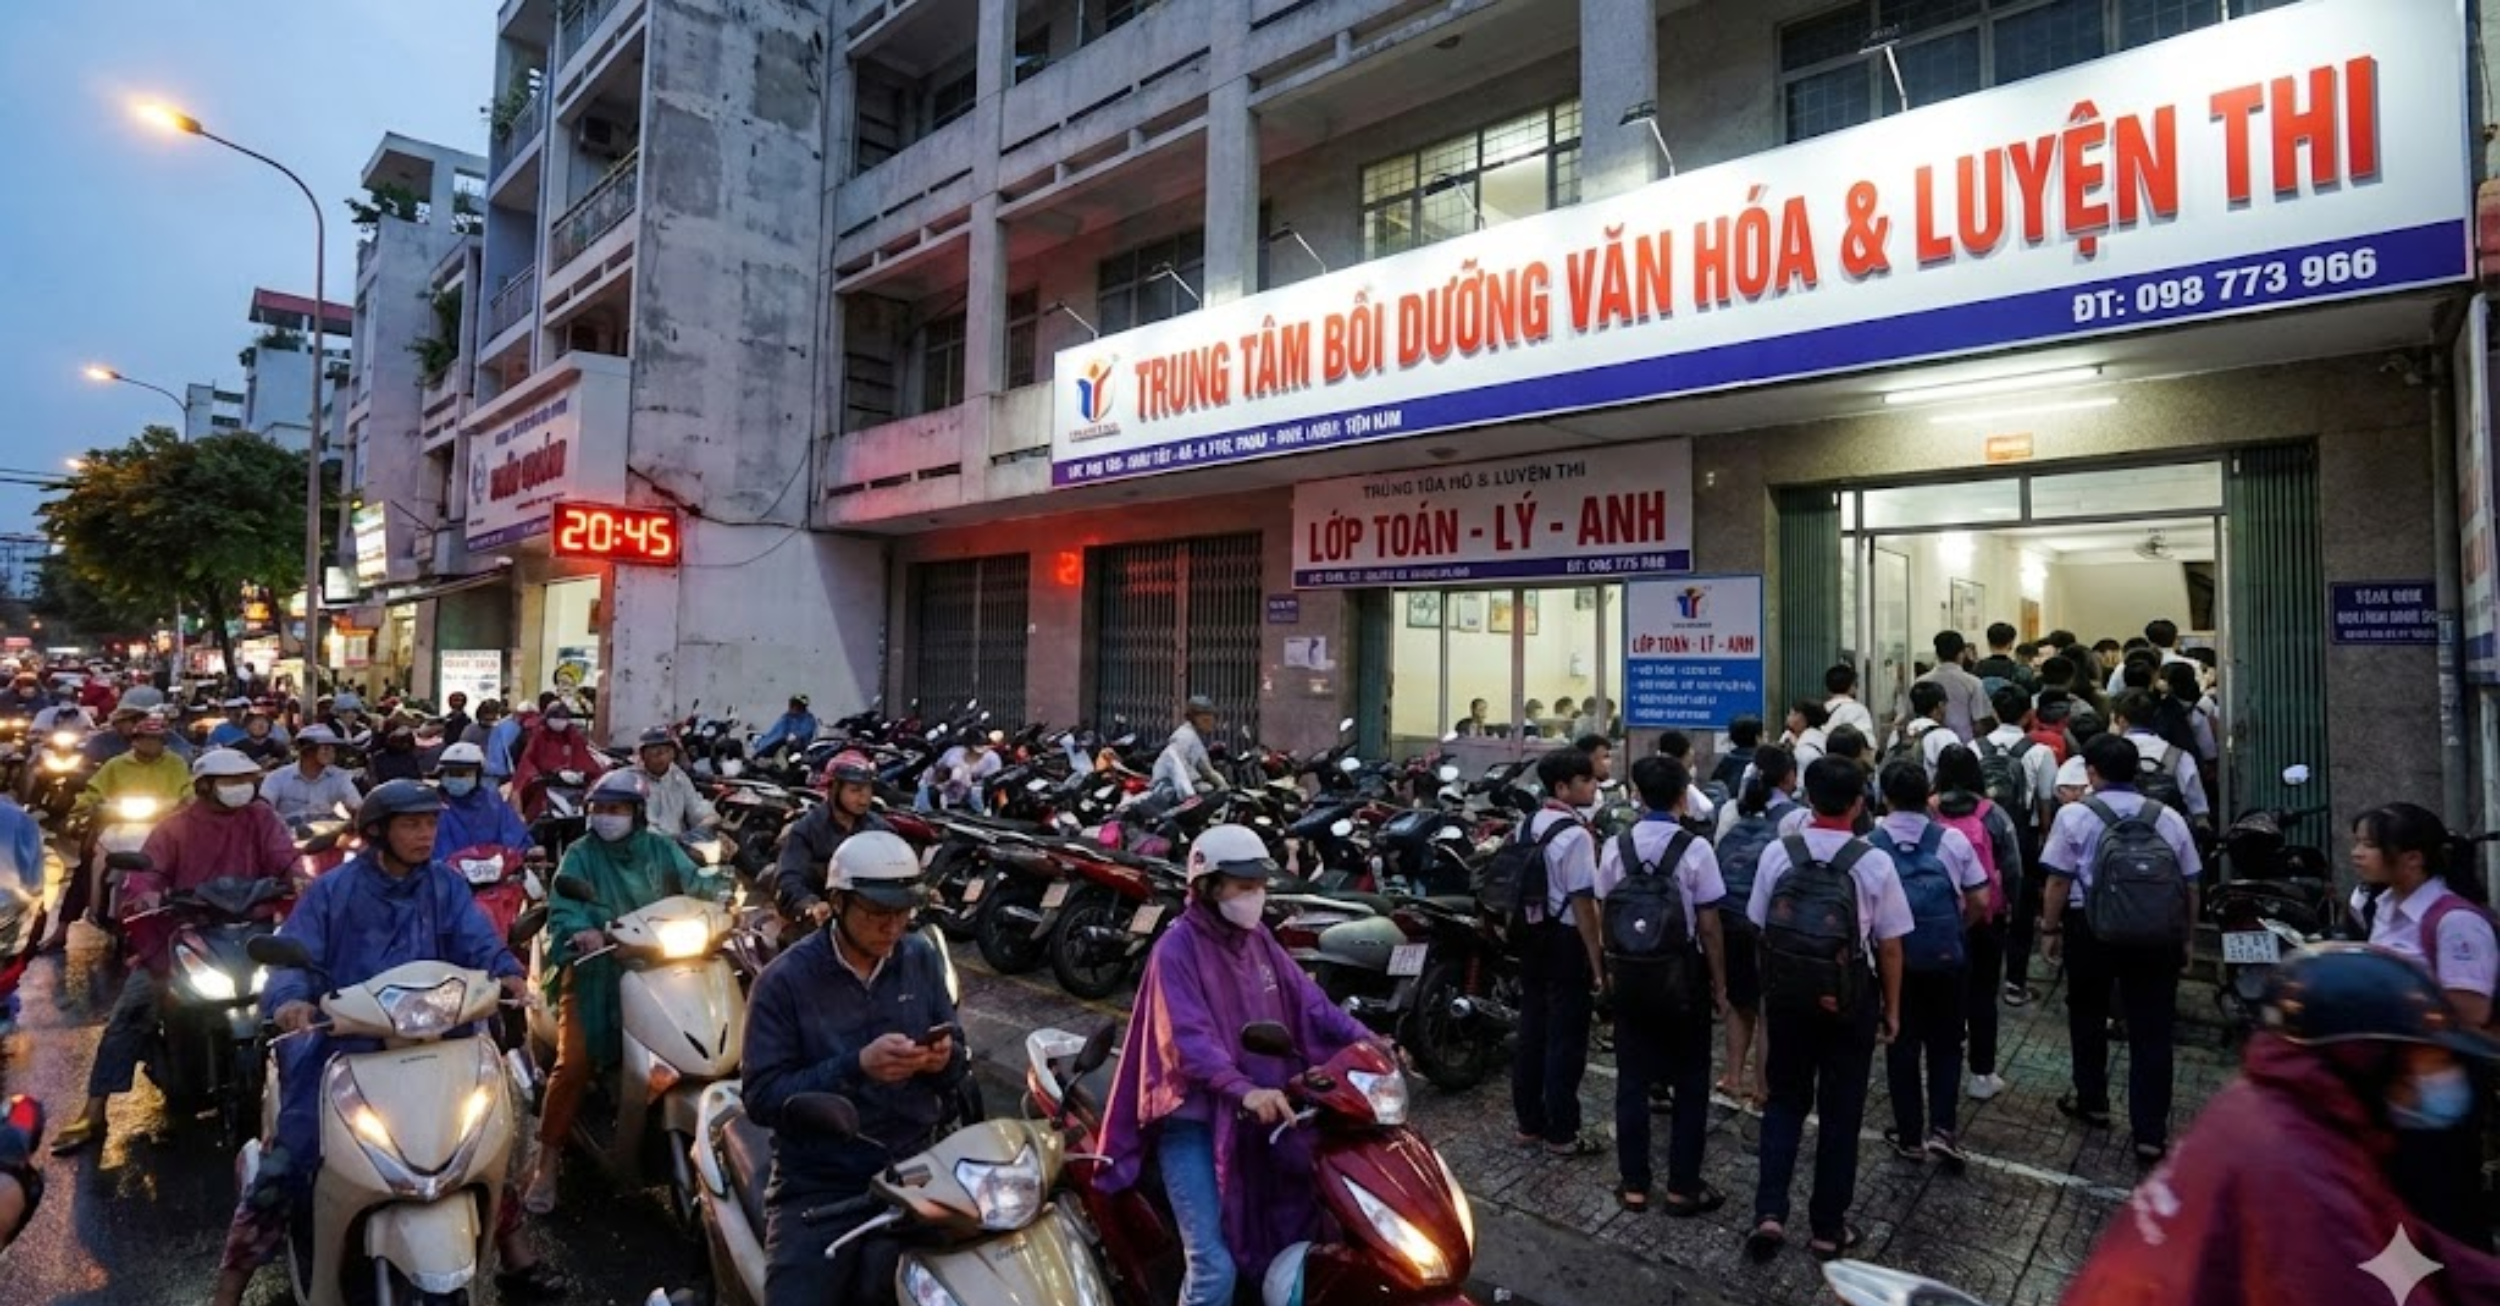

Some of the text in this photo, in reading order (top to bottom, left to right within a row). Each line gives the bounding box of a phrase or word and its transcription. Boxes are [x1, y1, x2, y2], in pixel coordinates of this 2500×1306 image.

[1135, 342, 1230, 420] TRUNG
[1240, 314, 1310, 397] TÂM
[1567, 222, 1673, 333] VĂN
[1694, 184, 1818, 311] HÓA
[1840, 180, 1890, 278] &
[1915, 99, 2180, 260] LUYỆN
[2209, 55, 2379, 206] THI
[2073, 287, 2126, 323] ĐT:
[2215, 262, 2288, 300] 773
[2301, 248, 2377, 288] 966
[560, 510, 672, 556] 20:45
[1309, 490, 1666, 563] LỚP TOÁN - LÝ - ANH
